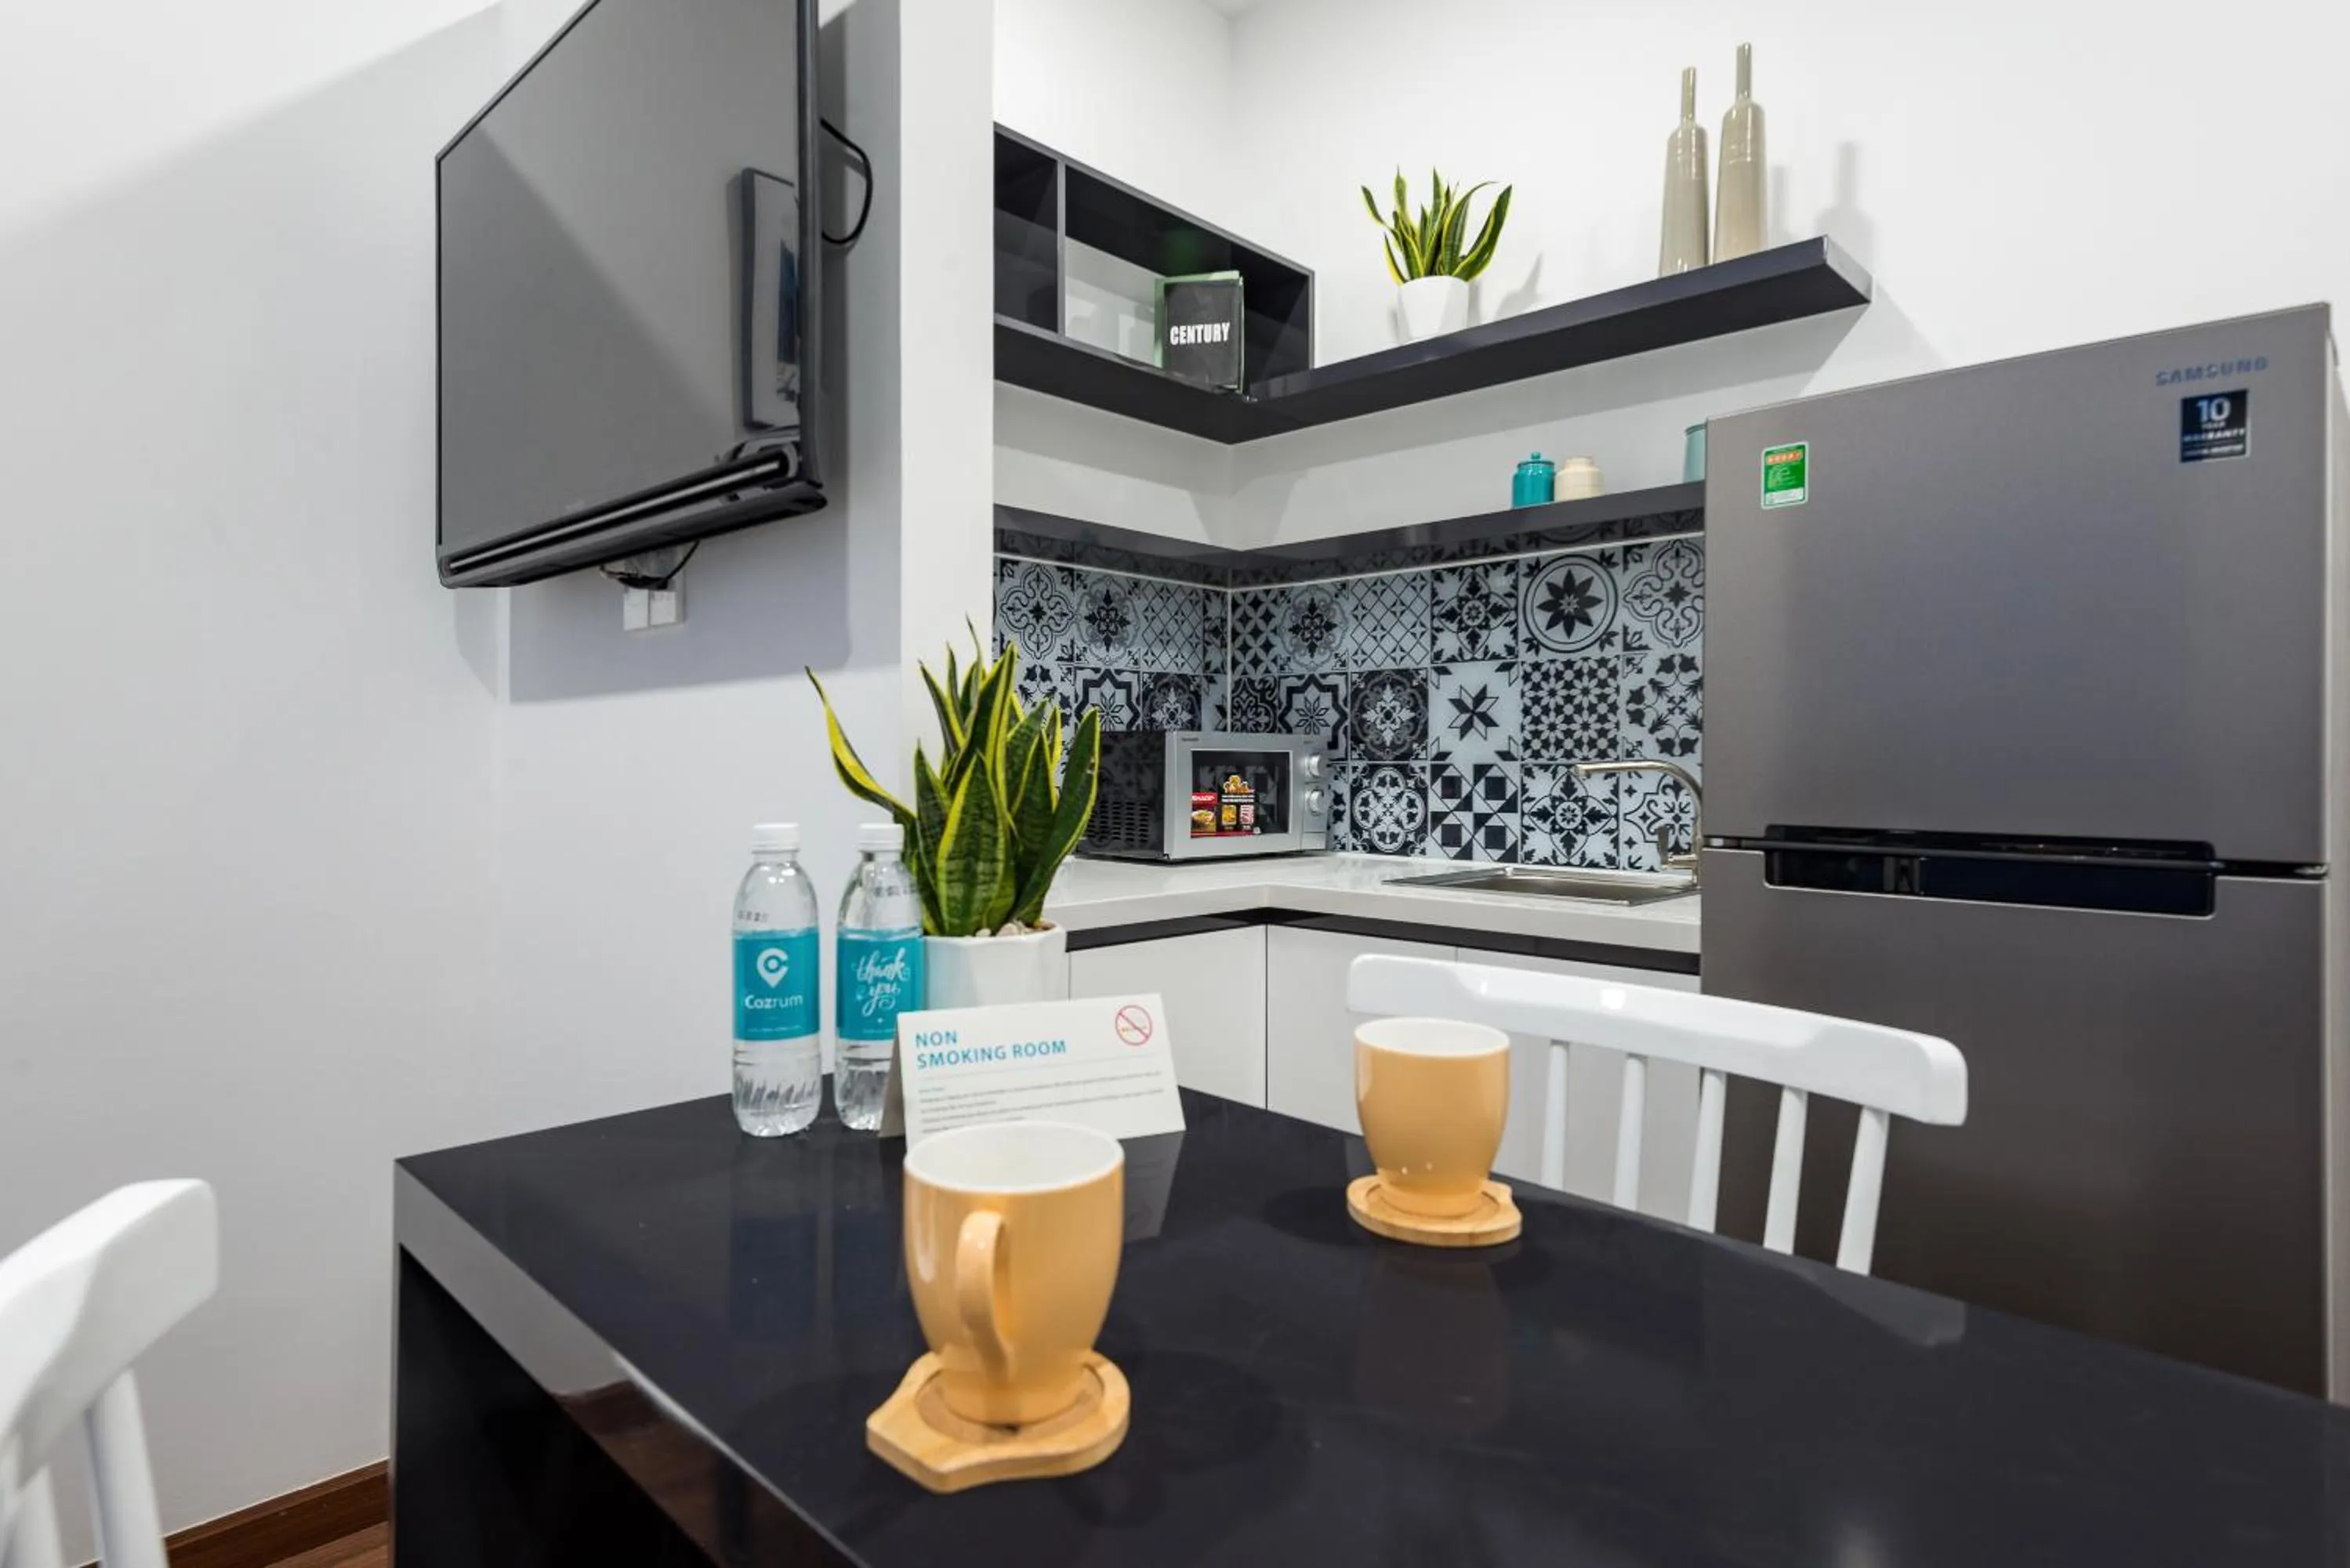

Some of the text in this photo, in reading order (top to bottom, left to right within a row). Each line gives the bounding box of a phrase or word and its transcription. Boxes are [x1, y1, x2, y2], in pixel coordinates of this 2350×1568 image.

[1170, 321, 1231, 346] CENTURY
[2156, 357, 2268, 386] SAMSUNG
[2196, 397, 2231, 422] 10
[916, 1030, 958, 1048] NON
[916, 1040, 1066, 1070] SMOKING ROOM
